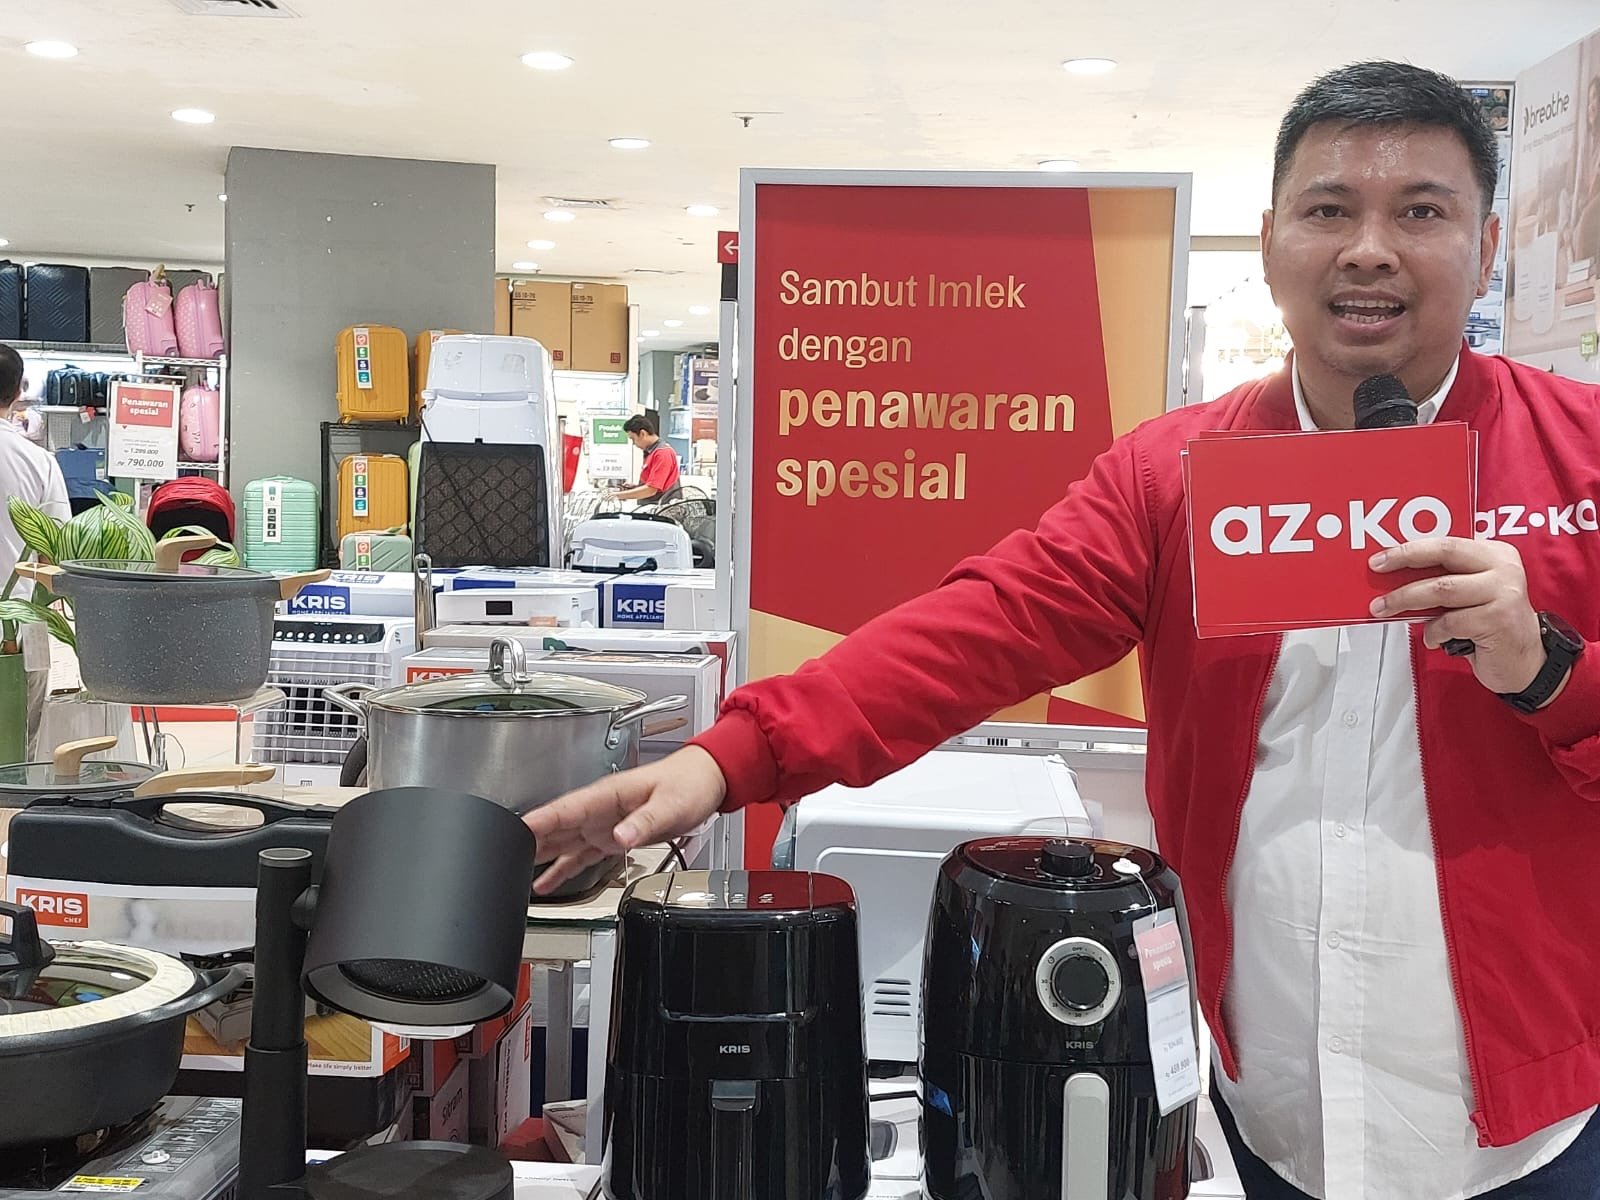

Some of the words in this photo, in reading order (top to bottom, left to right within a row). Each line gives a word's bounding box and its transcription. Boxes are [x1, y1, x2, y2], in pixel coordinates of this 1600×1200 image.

[779, 270, 917, 307] Sambut
[928, 274, 1026, 309] Imlek
[778, 327, 912, 369] dengan
[121, 397, 169, 409] Penawaran
[129, 407, 159, 416] spesial
[778, 386, 1076, 436] penawaran
[776, 448, 967, 506] spesial
[292, 594, 346, 610] KRIS
[617, 599, 665, 613] KRIS
[21, 893, 83, 916] KRIS
[63, 916, 82, 924] CHEF
[719, 1044, 751, 1054] KRIS
[1065, 1041, 1094, 1049] KRIS
